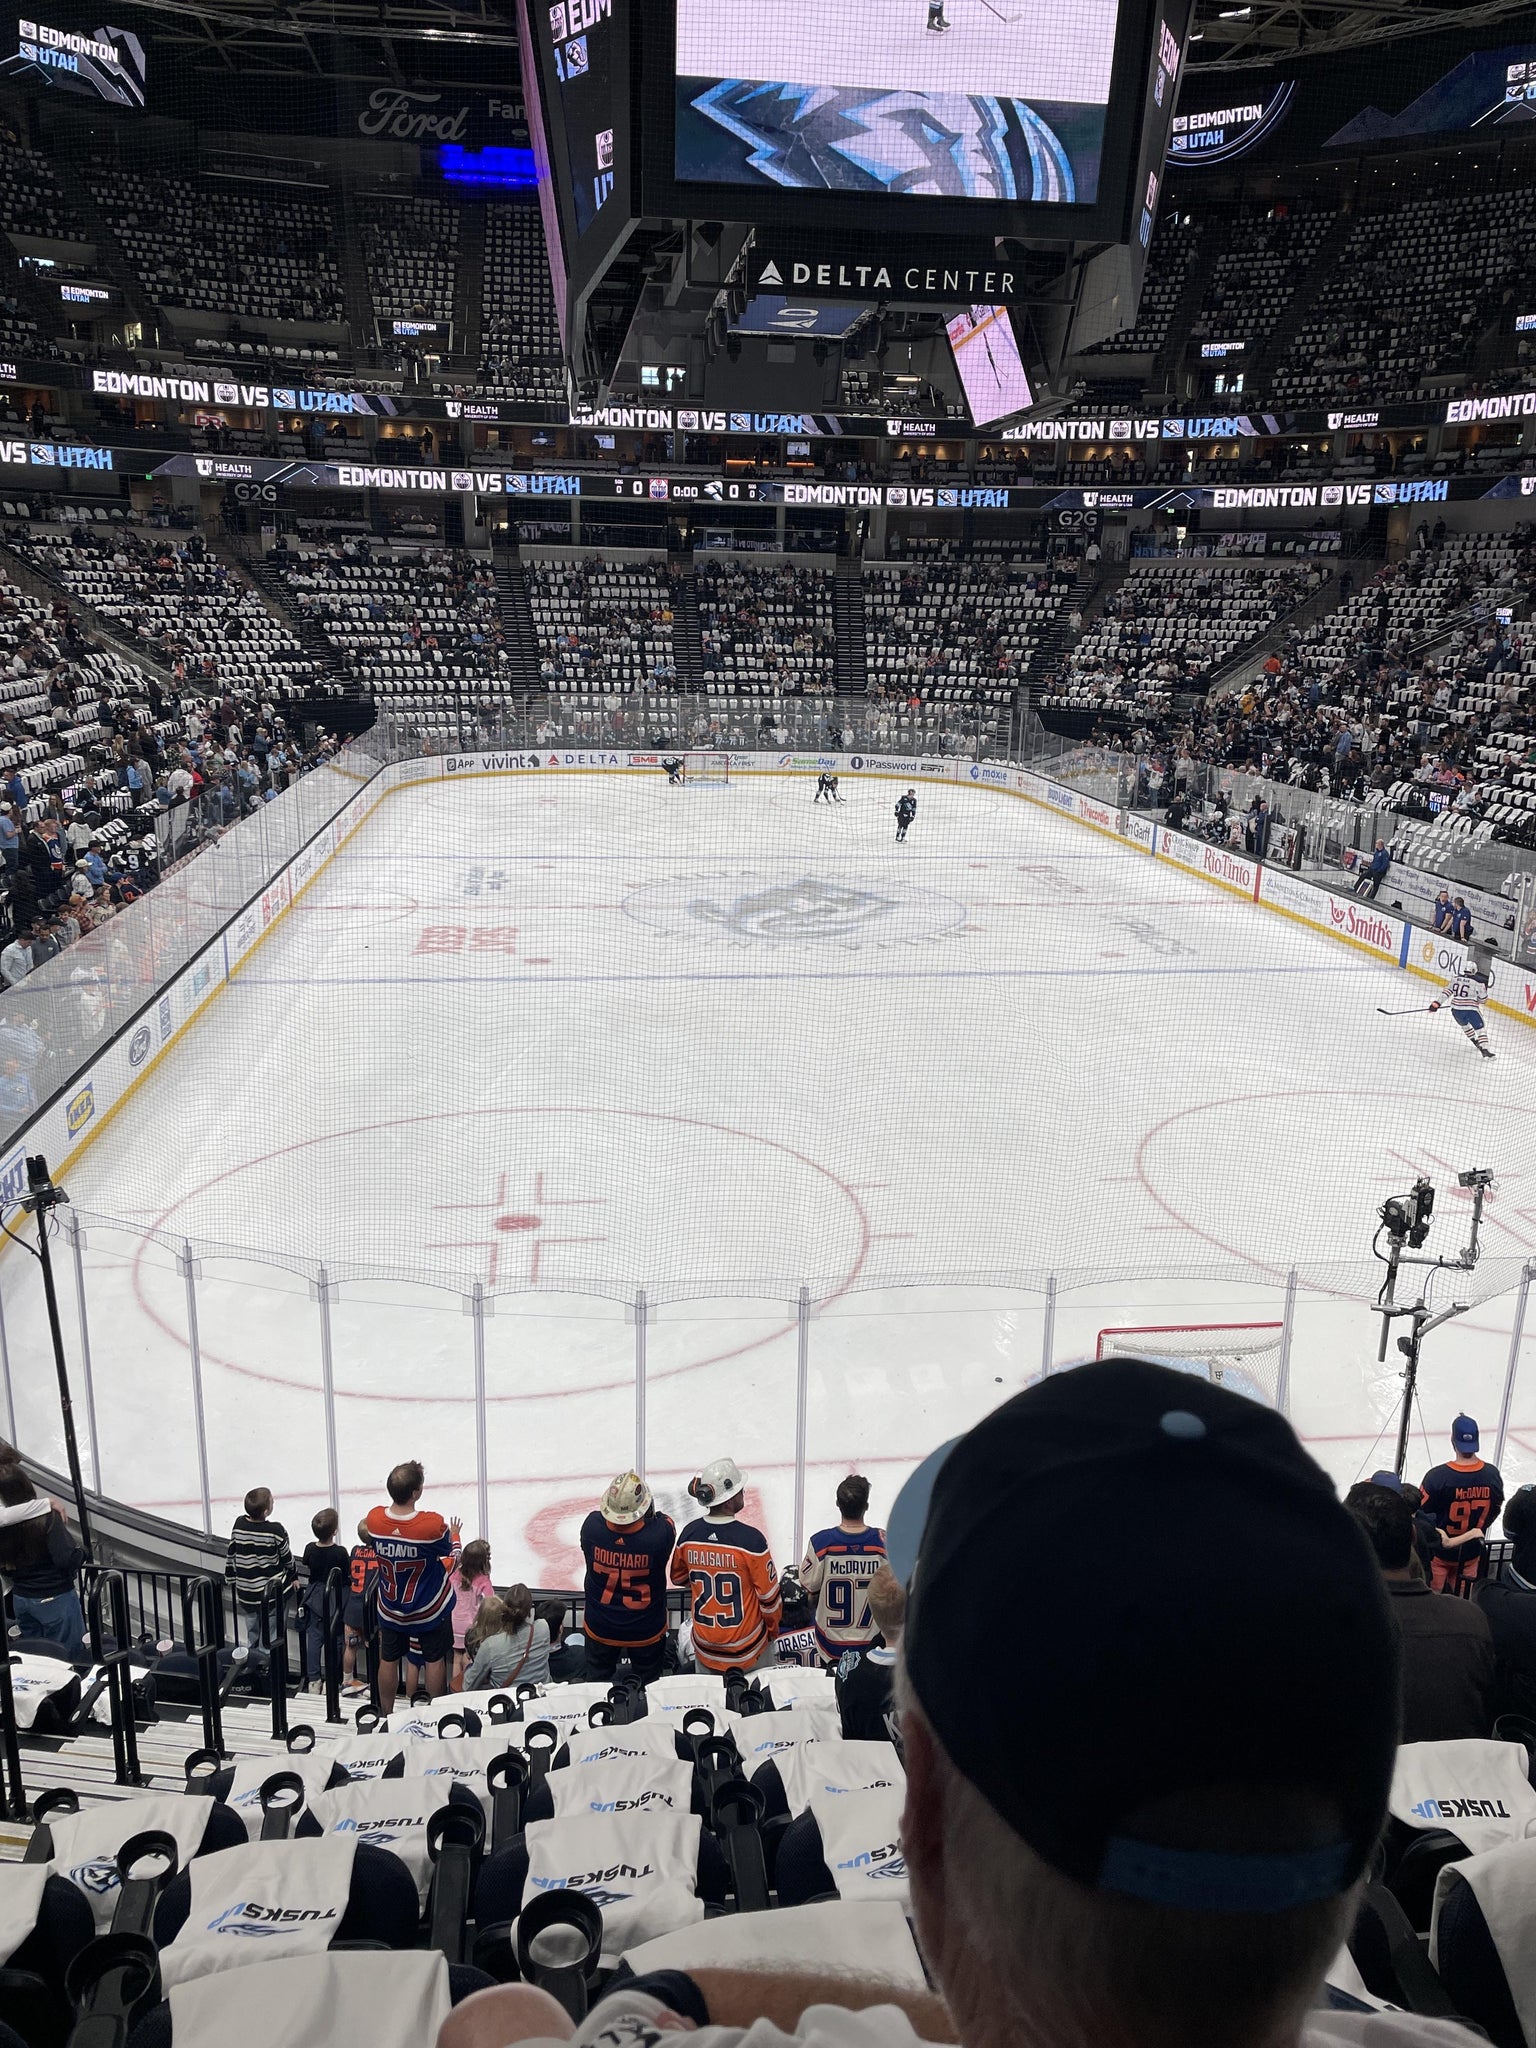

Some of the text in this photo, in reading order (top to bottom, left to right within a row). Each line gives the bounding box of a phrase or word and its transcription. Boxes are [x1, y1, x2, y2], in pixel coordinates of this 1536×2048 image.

[39, 25, 119, 63] EDMONTON
[36, 47, 79, 72] UTAH
[358, 88, 470, 140] Ford
[1189, 104, 1263, 130] EDMONTON
[1189, 130, 1224, 149] UTAH
[793, 263, 1015, 294] DELTA CENTER
[70, 286, 109, 299] EDMONTON
[71, 294, 90, 303] UTAH
[402, 321, 437, 331] EDMONTON
[1209, 349, 1226, 357] UTAH
[1210, 342, 1245, 351] EDMONTON
[93, 370, 354, 413] EDMONTON VS UTAH
[463, 405, 499, 415] HEALTH
[1344, 413, 1379, 424] HEALTH
[701, 412, 727, 431] VS
[754, 415, 803, 434] UTAH
[903, 423, 936, 432] HEALTH
[1134, 420, 1158, 439] VS
[1187, 416, 1238, 438] UTAH
[58, 446, 113, 470] UTAH
[215, 463, 252, 474] HEALTH
[339, 466, 580, 495] EDMONTON VS UTAH
[616, 480, 755, 498] 0 0 0:00 0 0
[234, 482, 277, 501] G2G
[784, 485, 1009, 508] EDMONTON VS UTAH
[1099, 494, 1134, 503] HEALTH
[1213, 480, 1449, 508] EDMONTON VS UTAH
[1058, 510, 1098, 526] G2G
[565, 754, 618, 764] DELTA
[865, 758, 917, 771] 1Password
[982, 767, 1008, 781] moxie
[1048, 786, 1073, 808] BUD LIGHT
[128, 855, 139, 870] 9
[1347, 905, 1392, 950] Smith's
[1452, 983, 1470, 998] 96
[69, 1096, 92, 1126] IKEA
[1455, 1486, 1490, 1499] McDAVID
[1446, 1500, 1491, 1535] 97
[375, 1541, 418, 1558] McDAVID
[593, 1546, 649, 1568] BOUCHARD
[687, 1549, 738, 1569] DRAISAITL
[376, 1554, 426, 1605] 97
[593, 1562, 651, 1610] 75
[688, 1569, 744, 1629] 29
[825, 1578, 874, 1629] 97
